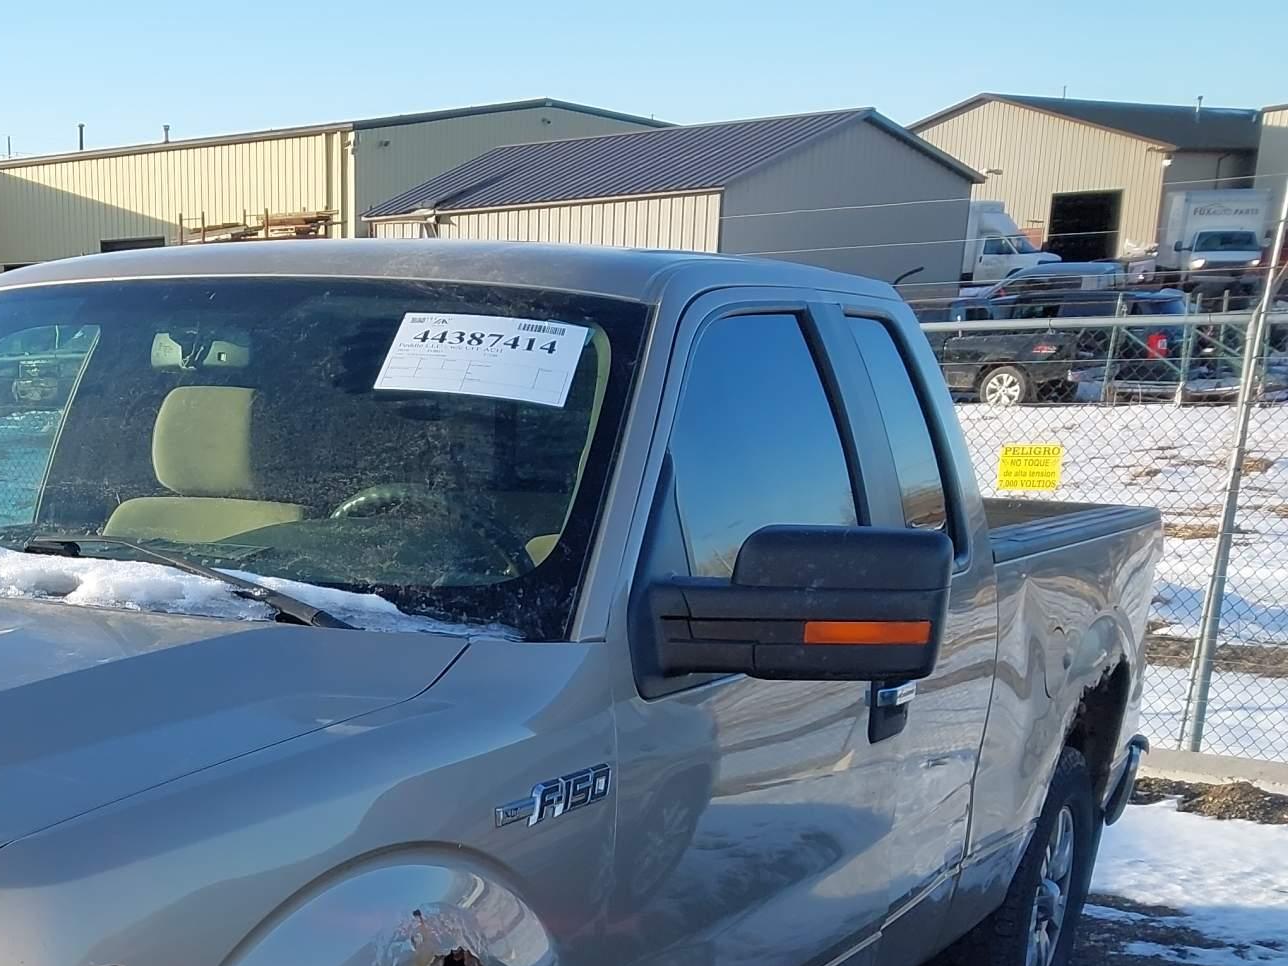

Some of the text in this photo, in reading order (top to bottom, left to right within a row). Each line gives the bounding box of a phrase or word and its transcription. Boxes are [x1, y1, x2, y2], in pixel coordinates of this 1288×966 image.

[413, 329, 556, 354] 44387414
[1004, 446, 1061, 456] PELIGRO
[1010, 459, 1050, 467] NO TOQUE
[1029, 470, 1056, 478] tension
[1020, 480, 1057, 489] VOLTIOS
